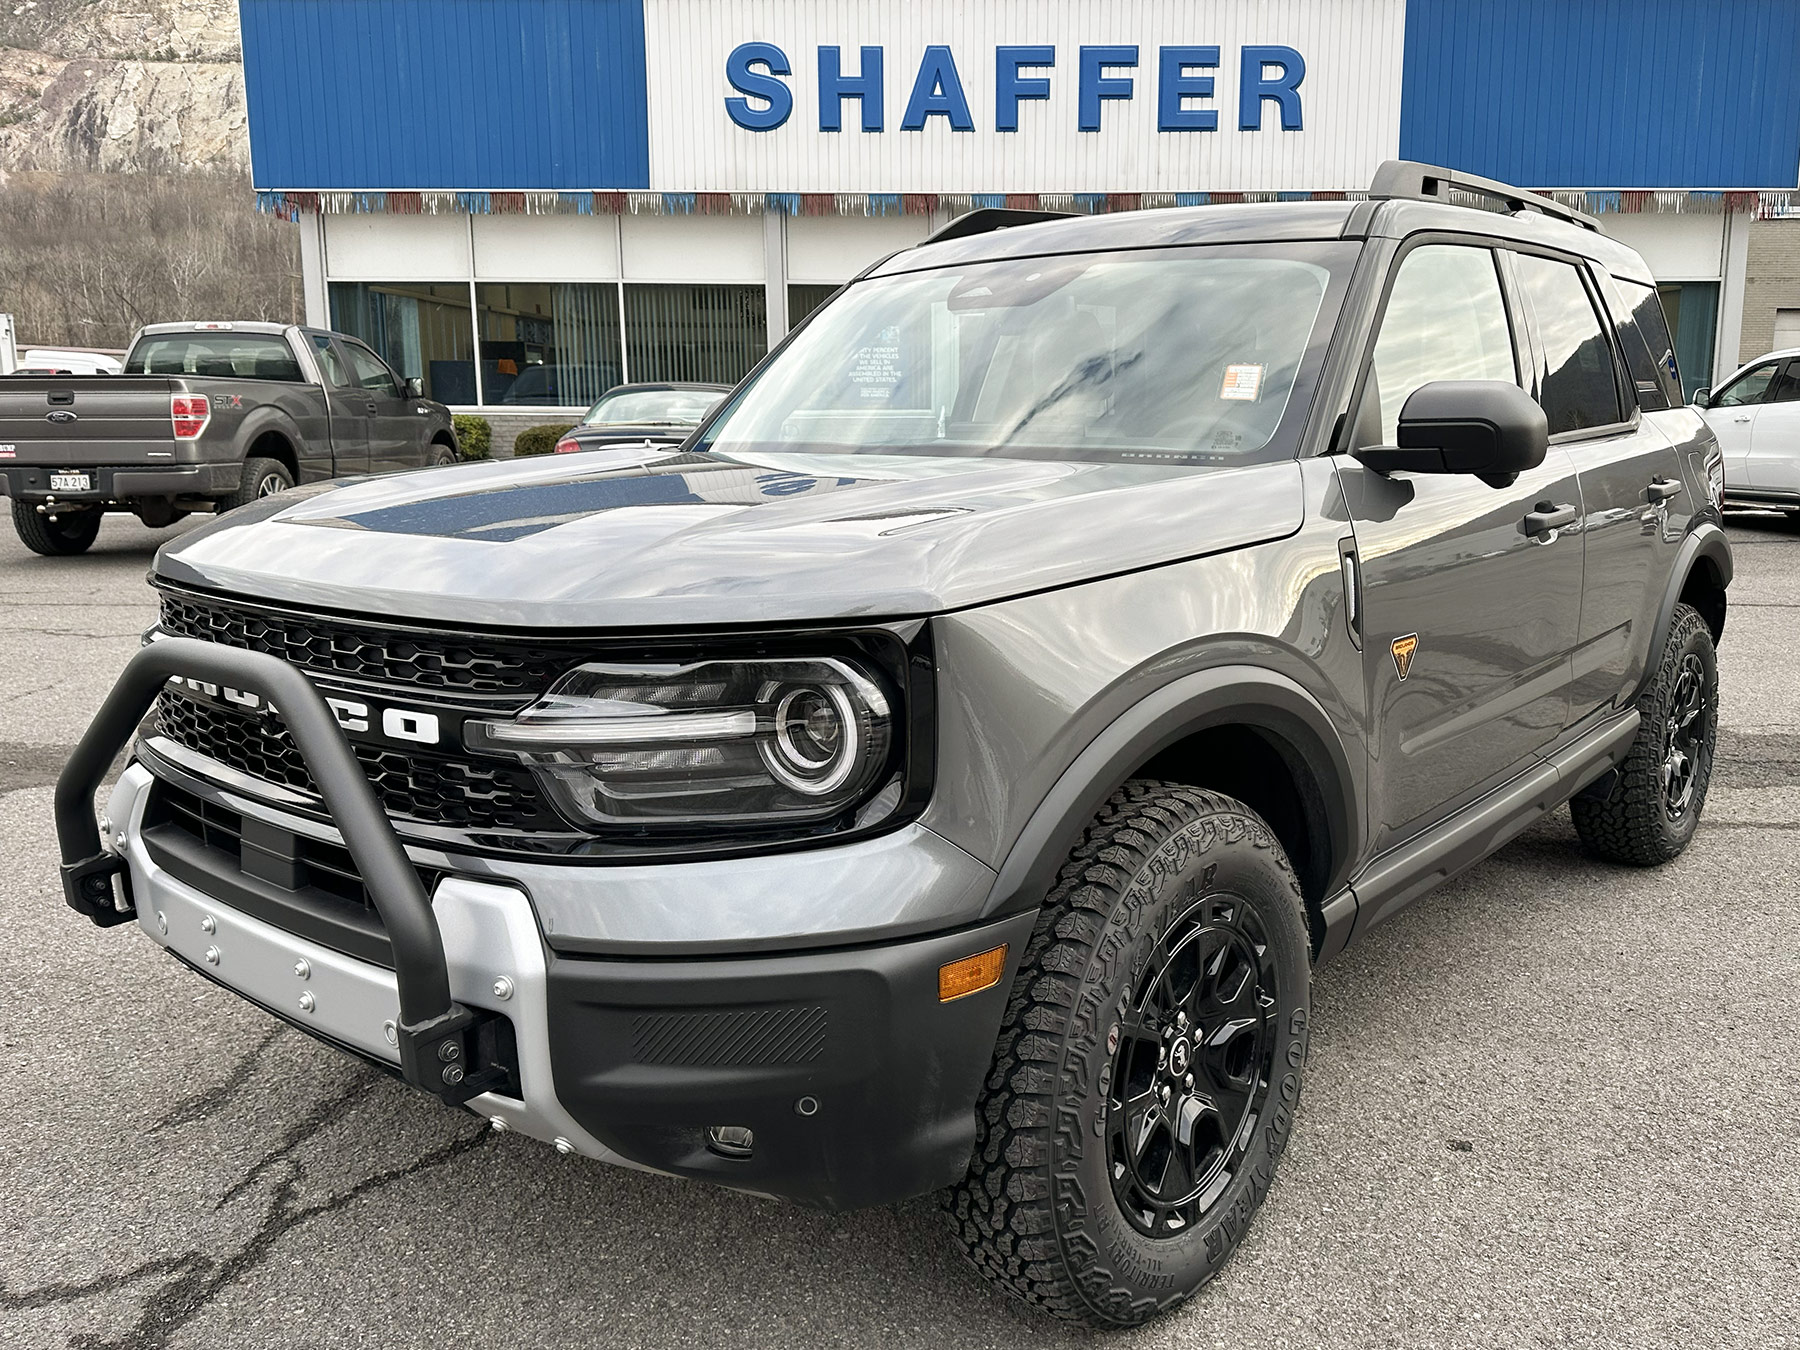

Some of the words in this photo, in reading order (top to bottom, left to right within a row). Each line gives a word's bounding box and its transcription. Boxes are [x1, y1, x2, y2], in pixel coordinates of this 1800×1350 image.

[725, 42, 1306, 132] SHAFFER
[214, 394, 242, 406] STX
[51, 477, 69, 488] 57A
[71, 477, 88, 488] 213
[1105, 1241, 1175, 1289] TERRITORY
